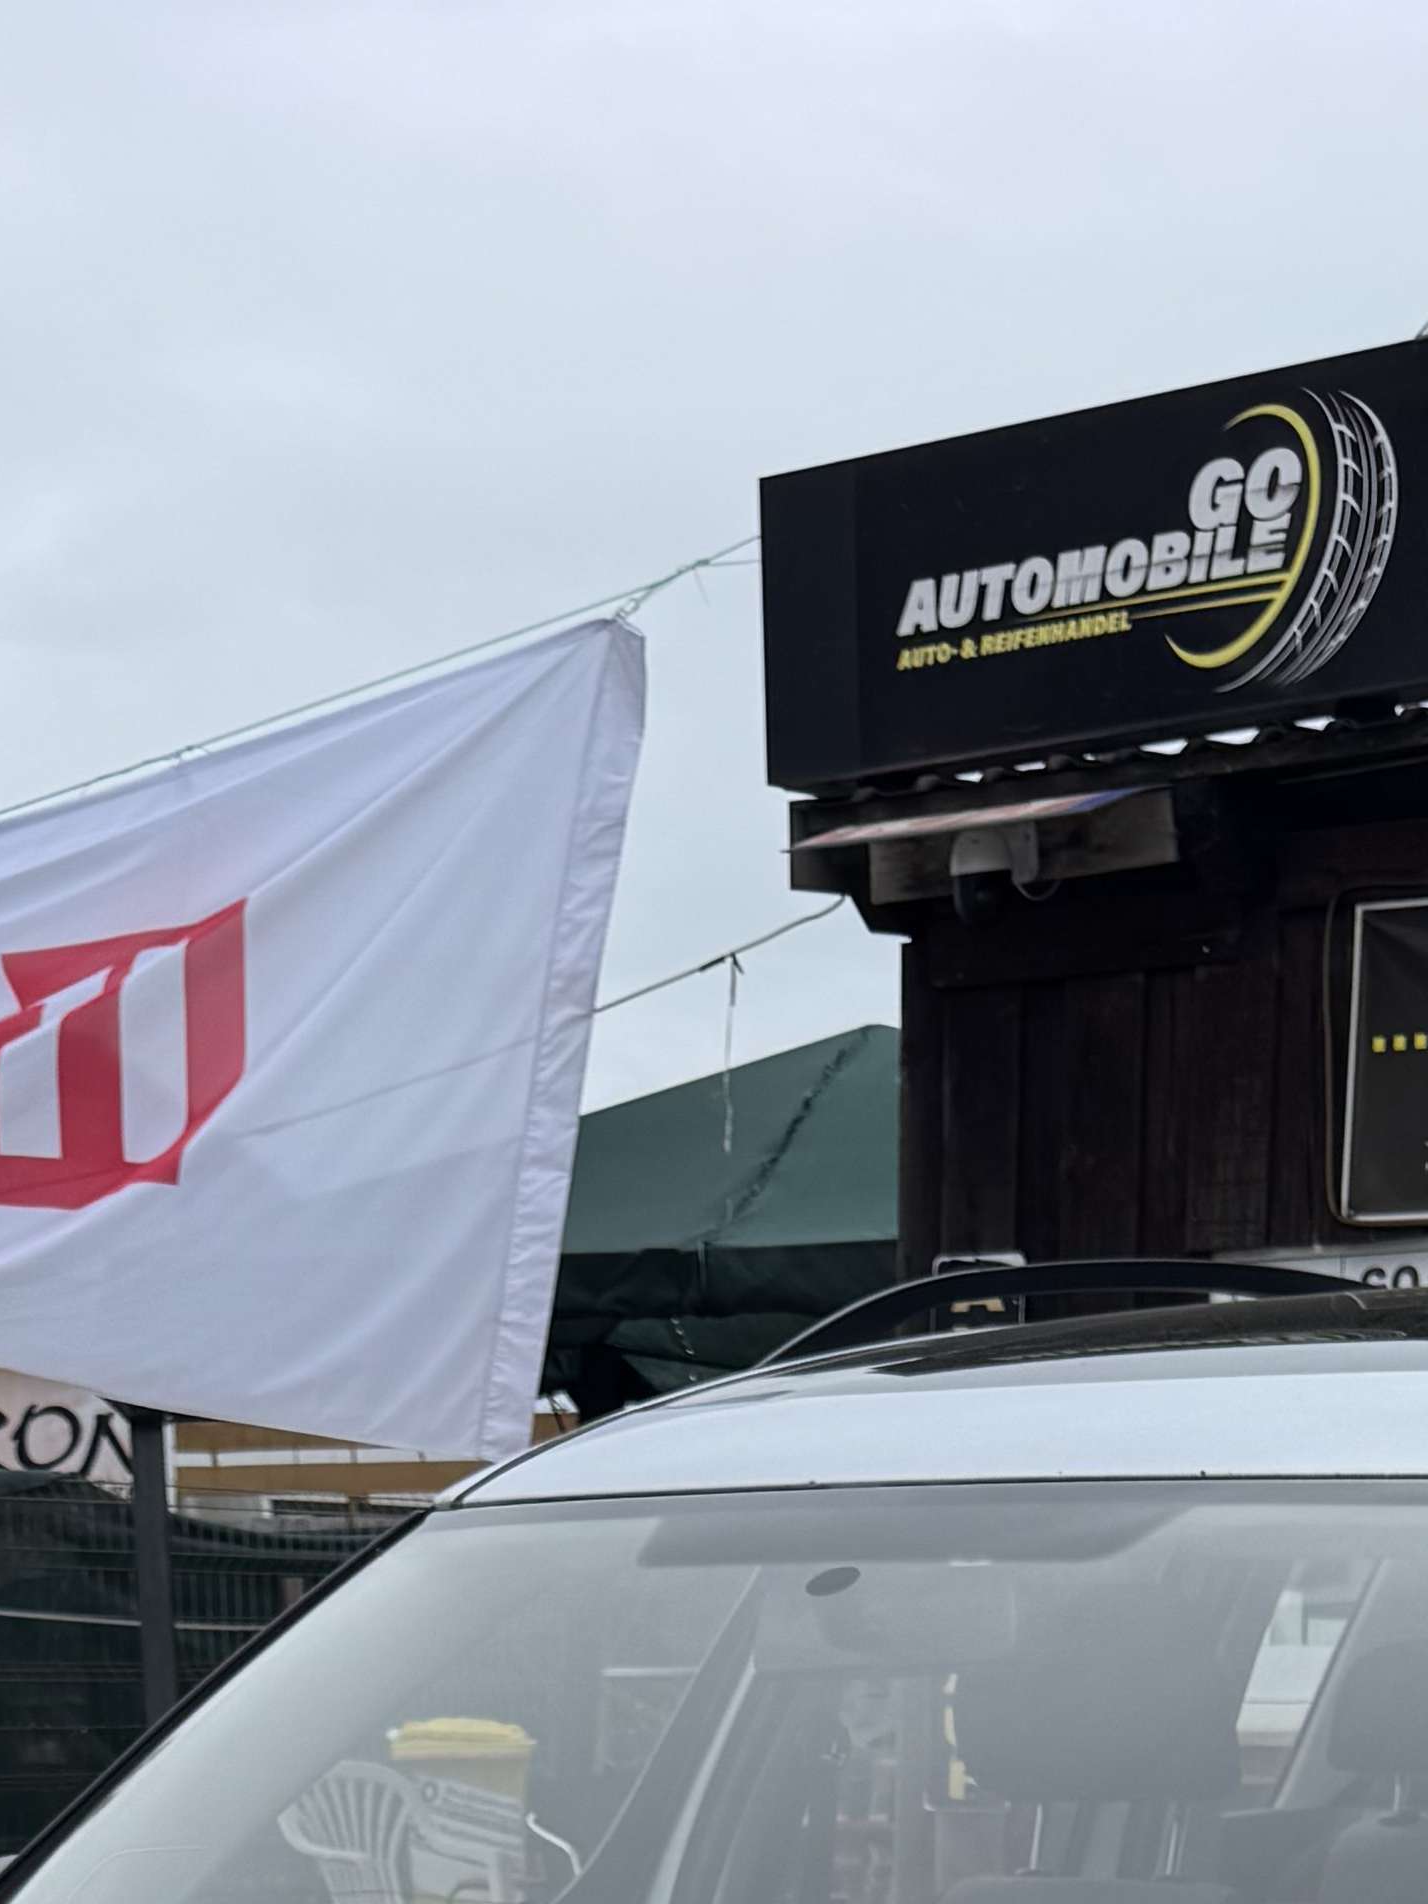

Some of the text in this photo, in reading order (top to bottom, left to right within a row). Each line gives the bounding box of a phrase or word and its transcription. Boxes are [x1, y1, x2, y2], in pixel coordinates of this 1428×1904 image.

[1188, 446, 1303, 531] GO
[895, 513, 1292, 638] AUTOMOBILE
[961, 634, 978, 659] &
[980, 610, 1132, 657] REIFENHANDEL
